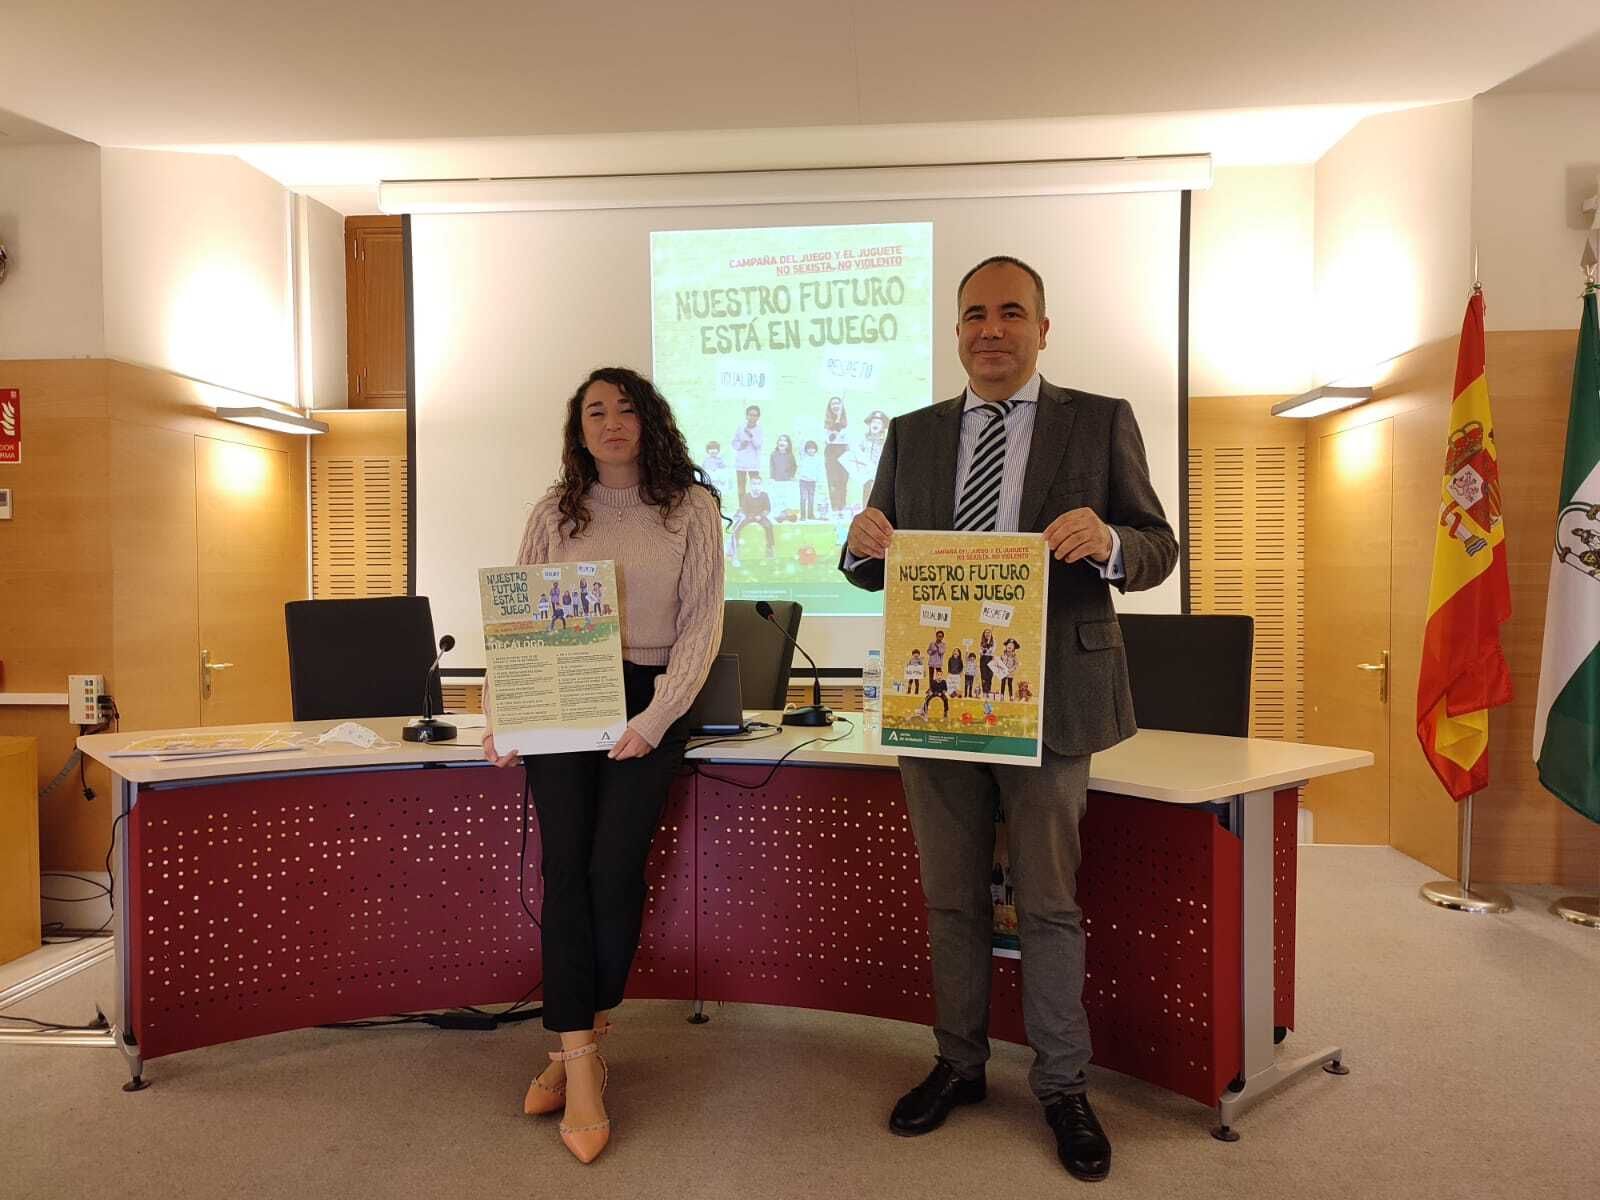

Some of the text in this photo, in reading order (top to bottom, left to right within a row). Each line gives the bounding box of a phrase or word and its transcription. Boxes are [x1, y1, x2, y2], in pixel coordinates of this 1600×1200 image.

[729, 245, 903, 268] CAMPAÑA DEL JUEGO Y EL JUGUETE
[776, 266, 791, 277] NO
[838, 260, 852, 272] NO
[854, 256, 903, 269] VIOLENTO
[675, 275, 905, 322] NUESTRO FUTURO
[701, 313, 898, 355] ESTÁ EN JUEGO
[487, 571, 528, 585] NUESTRO
[899, 563, 1030, 582] NUESTRO FUTURO
[491, 582, 528, 595] FUTURO
[517, 593, 529, 603] EN
[912, 582, 1025, 601] ESTÁ EN JUEGO
[500, 603, 531, 616] JUEGO
